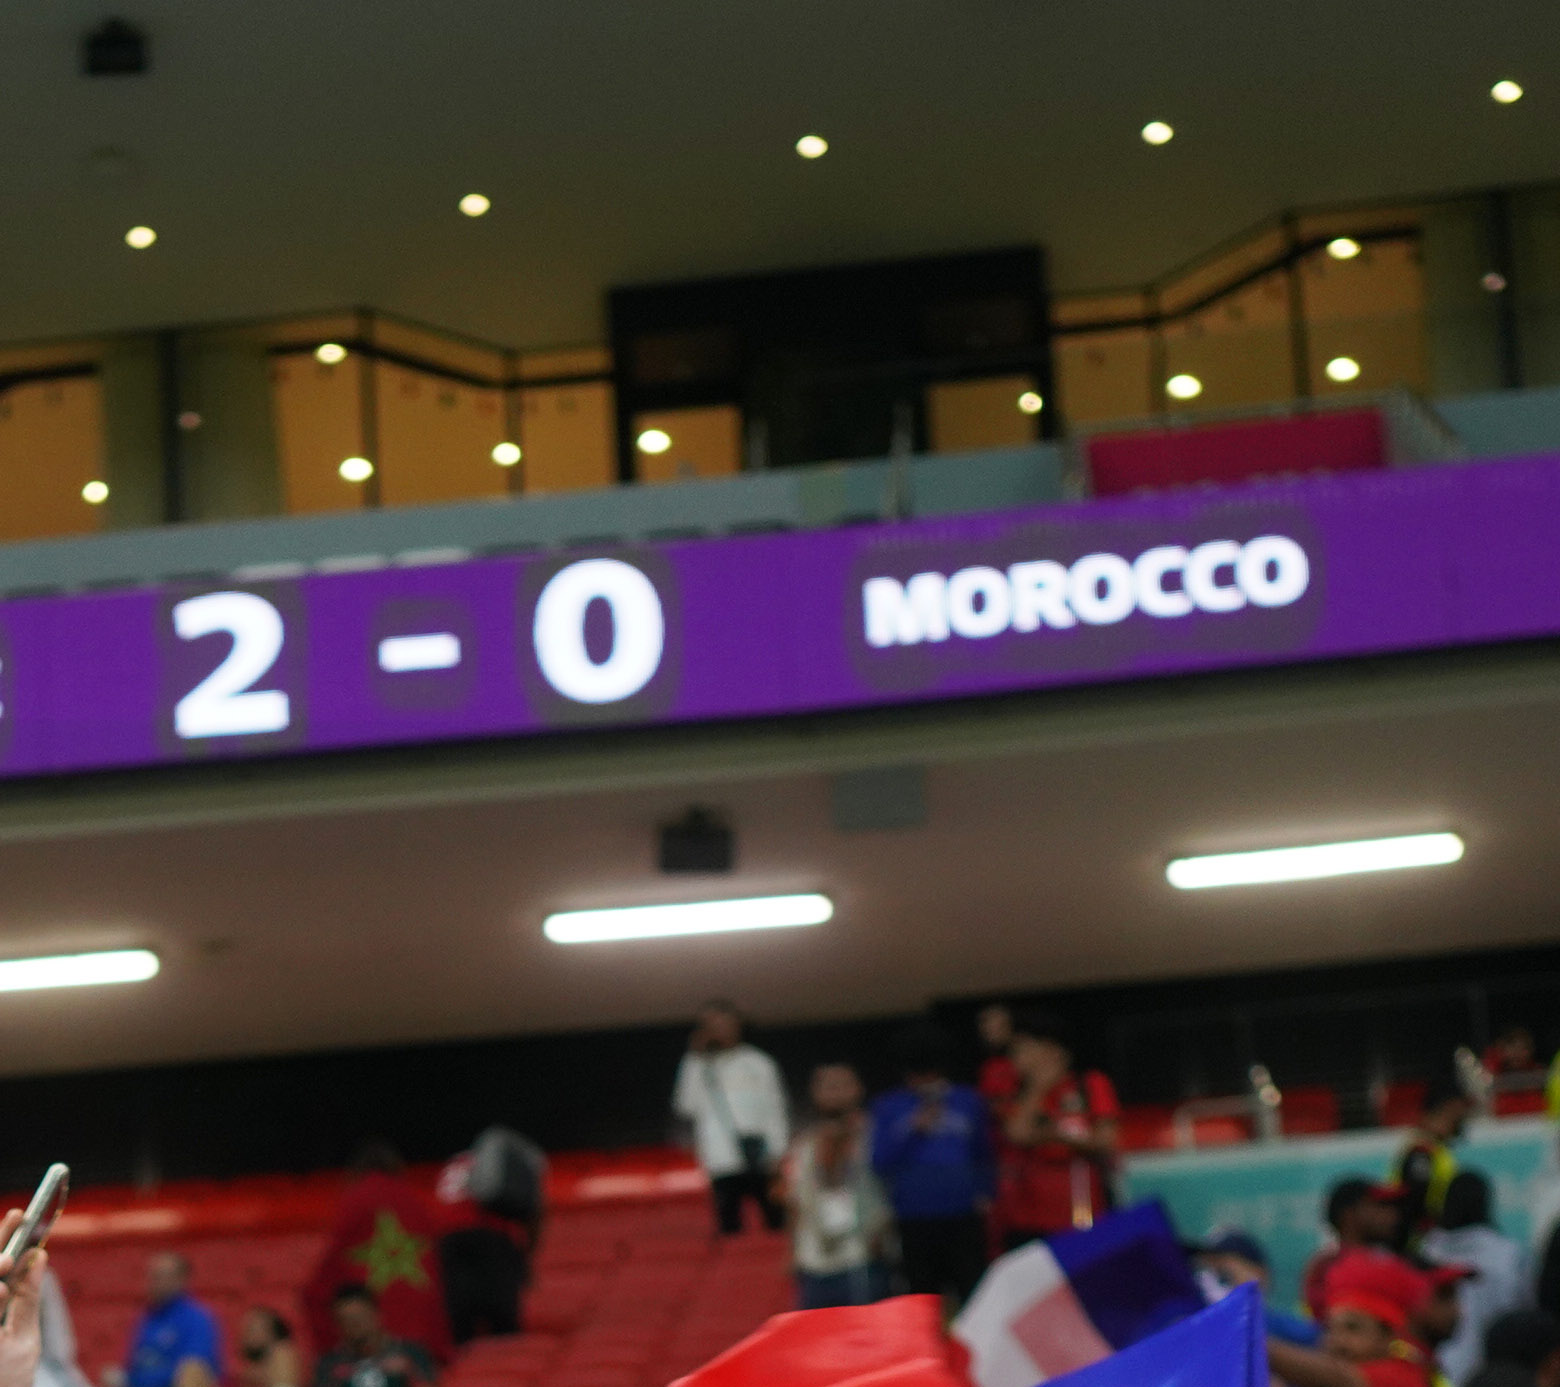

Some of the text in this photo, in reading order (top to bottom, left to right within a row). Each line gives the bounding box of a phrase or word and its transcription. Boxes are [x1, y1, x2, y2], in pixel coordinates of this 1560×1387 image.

[172, 590, 291, 740] 2
[532, 557, 665, 705] 0
[862, 534, 1310, 648] MOROCCO
